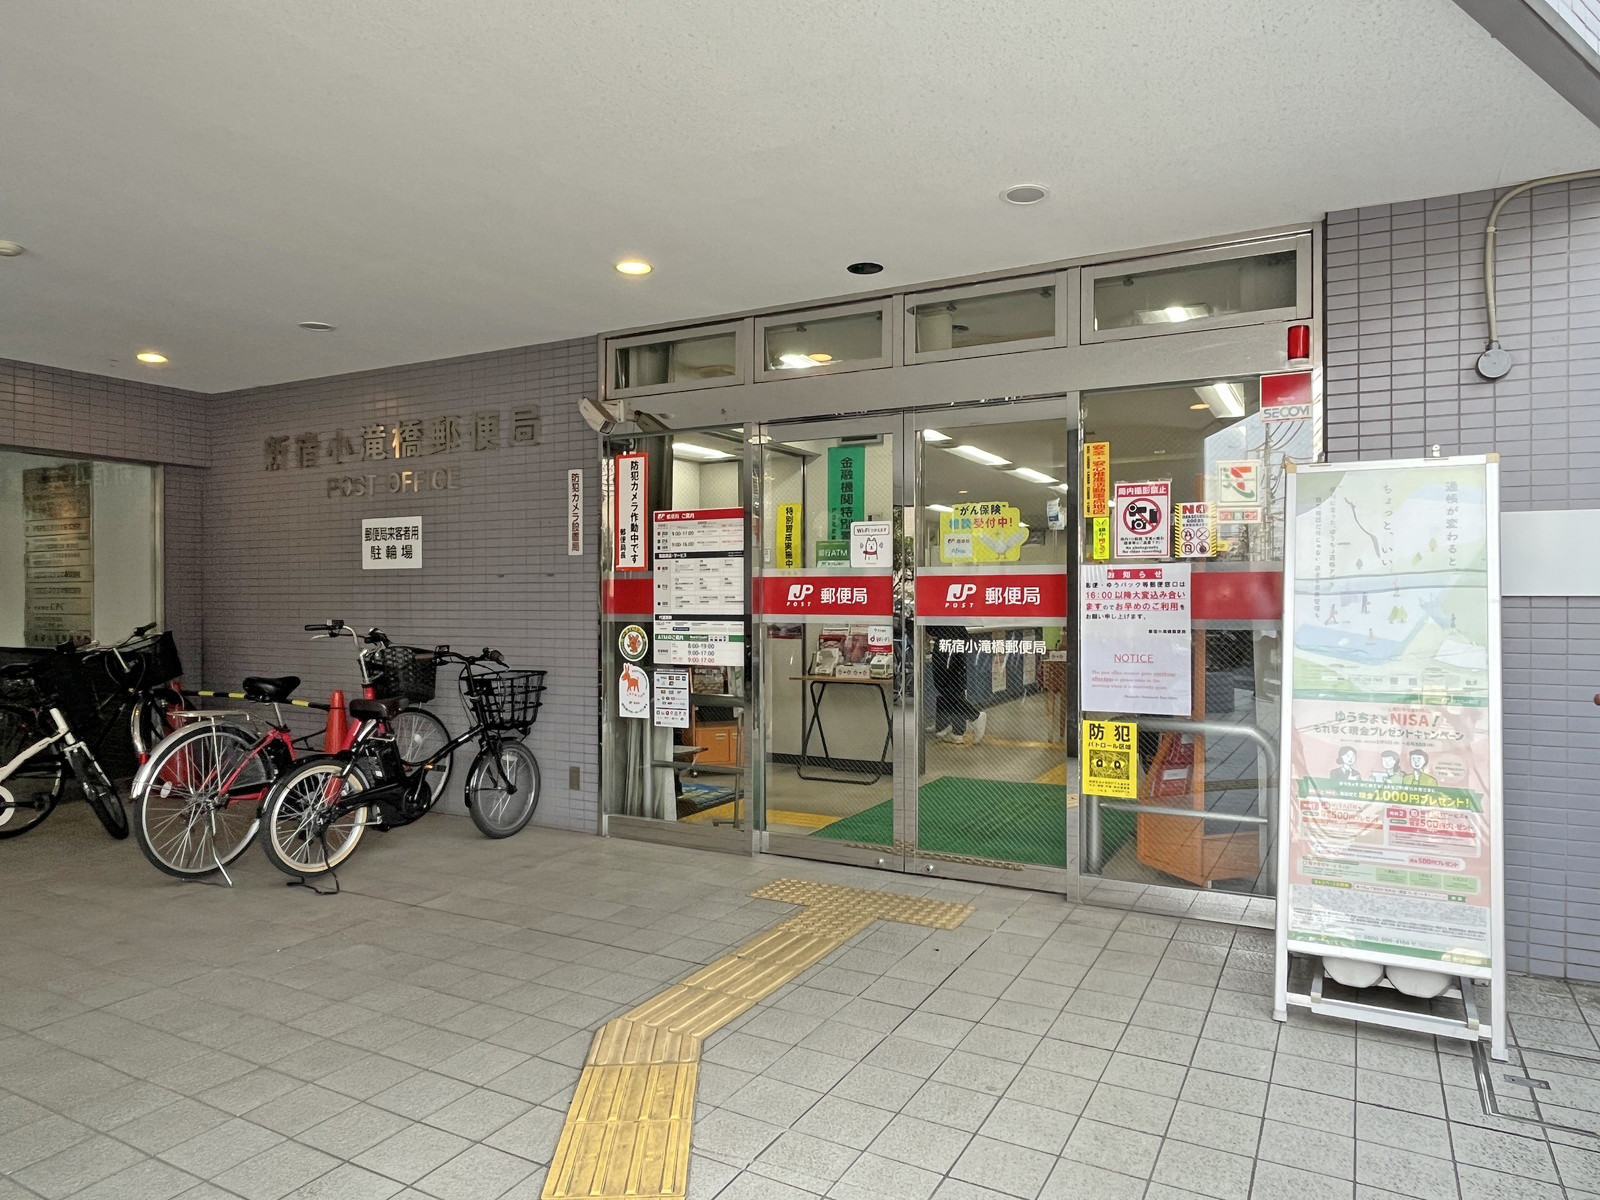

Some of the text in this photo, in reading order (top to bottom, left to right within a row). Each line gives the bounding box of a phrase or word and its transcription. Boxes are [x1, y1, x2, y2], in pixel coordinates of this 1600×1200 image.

[1264, 405, 1309, 418] SECOM
[263, 404, 542, 471] 新宿小滝橋郵便局
[327, 470, 462, 499] POST OFFICE
[630, 460, 639, 564] 防犯カメラ作動中です
[364, 525, 419, 541] 郵便局来客者用
[370, 544, 413, 560] 駐輪場
[1107, 570, 1162, 579] お知らせ
[820, 588, 868, 604] 郵便局
[985, 587, 1041, 605] 郵便局
[1086, 602, 1184, 611] ますのでお早めのご利用を
[938, 639, 1047, 655] 新宿小滝橋郵便局
[1114, 654, 1154, 663] NOTICE
[1089, 723, 1131, 742] 防犯
